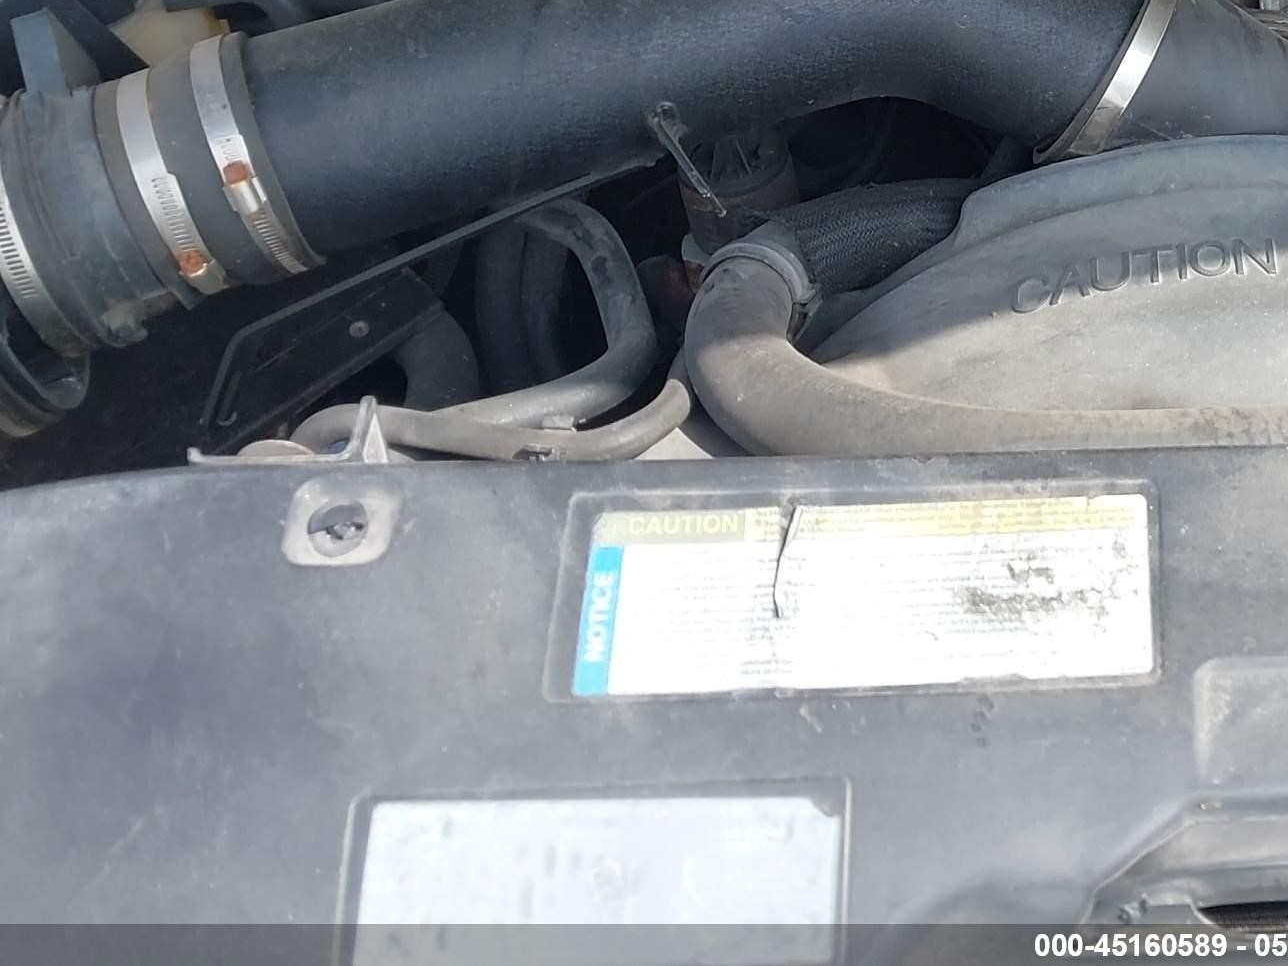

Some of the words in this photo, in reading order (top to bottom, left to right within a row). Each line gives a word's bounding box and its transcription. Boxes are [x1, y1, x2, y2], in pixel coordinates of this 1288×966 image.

[1010, 236, 1278, 316] CAUTION
[628, 512, 739, 538] CAUTION
[584, 570, 616, 662] NOTICE
